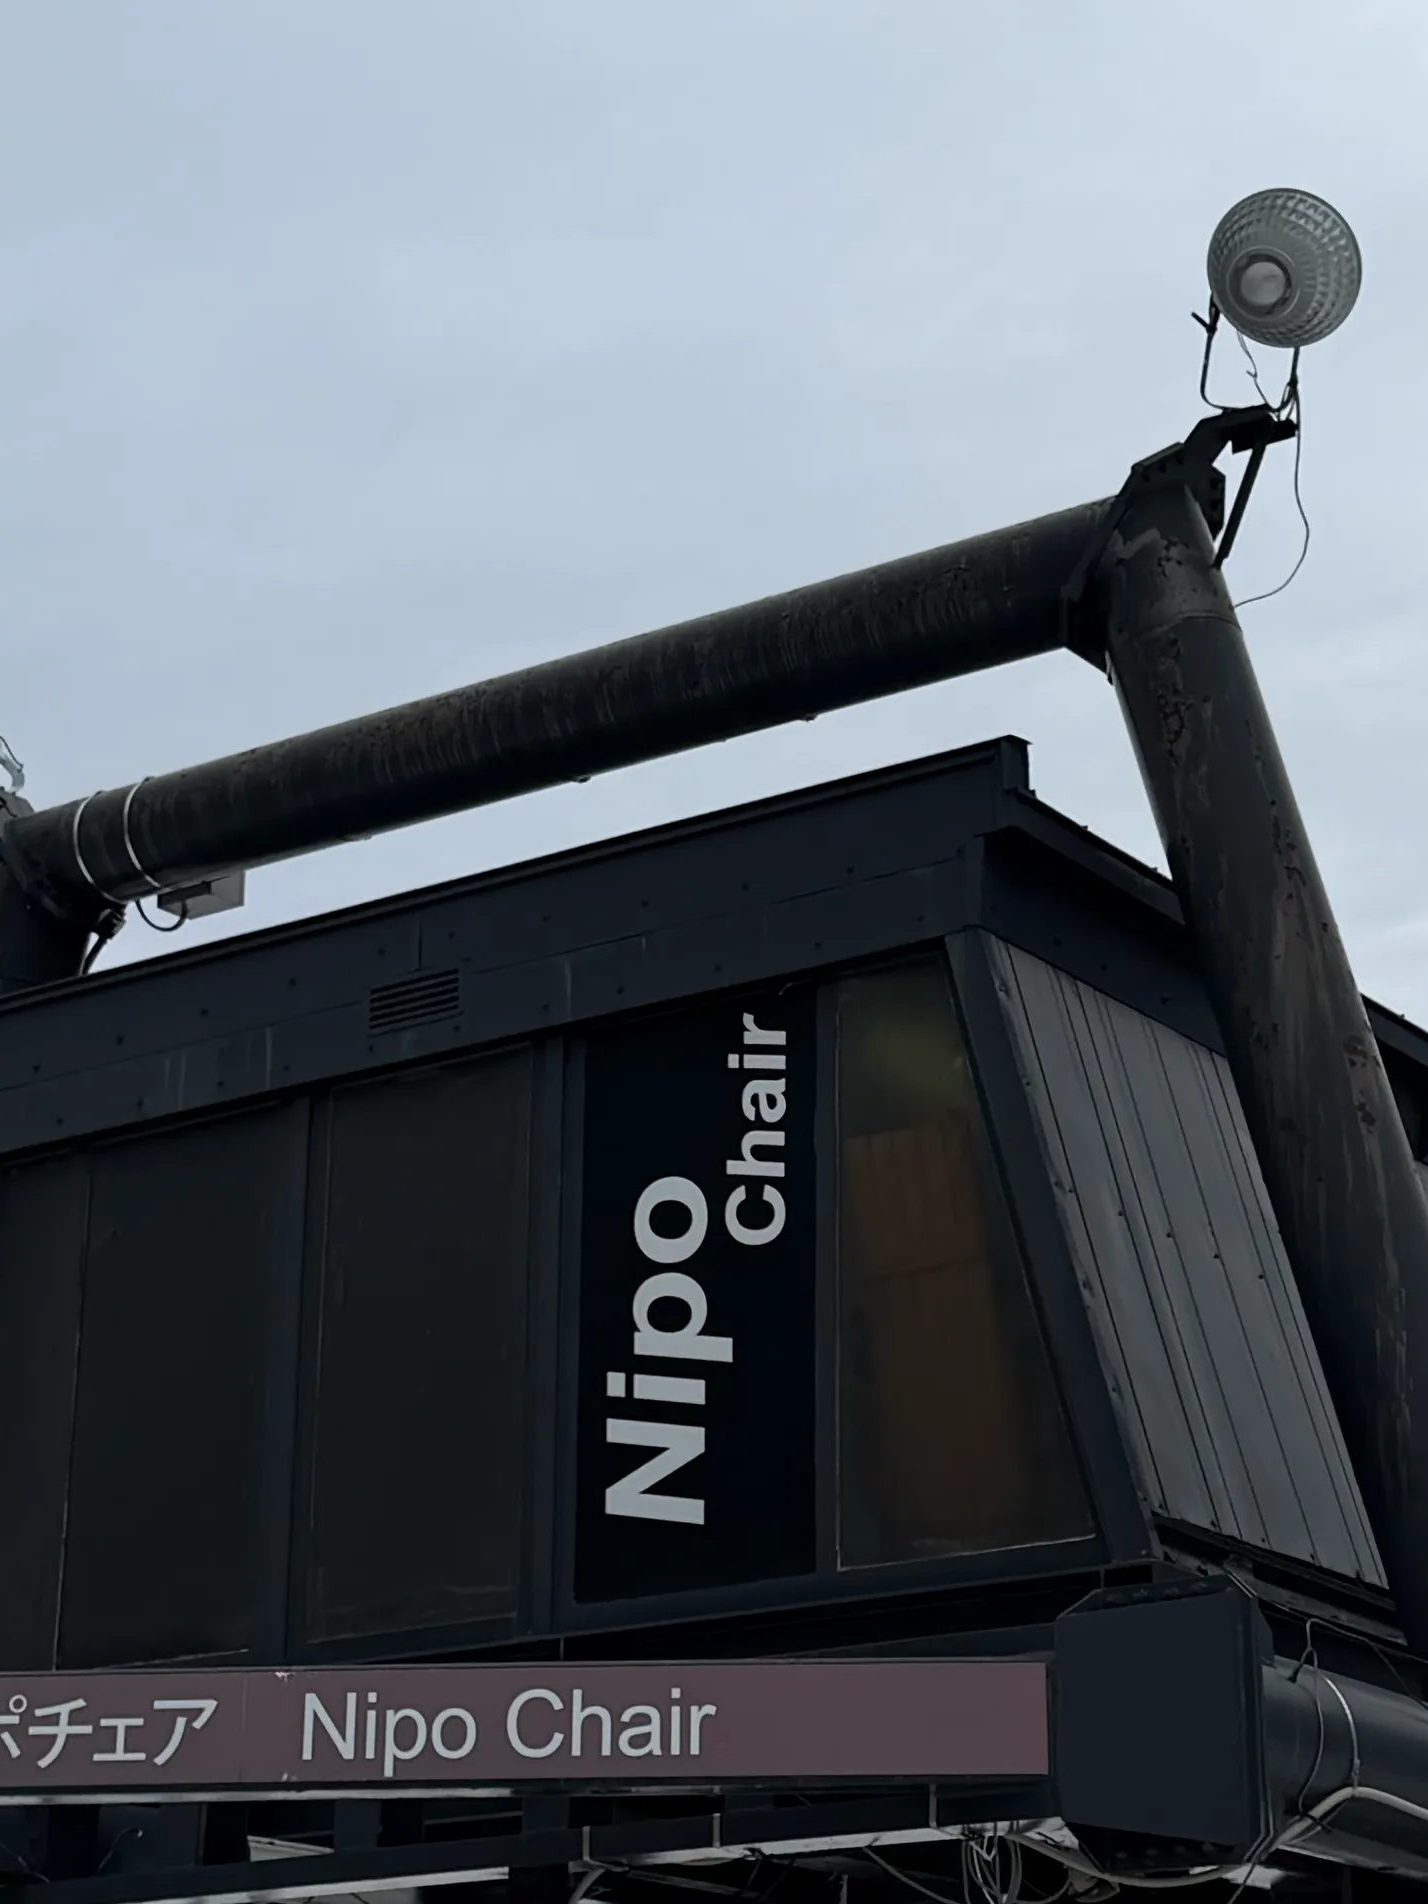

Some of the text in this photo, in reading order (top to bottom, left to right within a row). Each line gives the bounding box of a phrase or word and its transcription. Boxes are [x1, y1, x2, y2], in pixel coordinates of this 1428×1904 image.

[724, 1013, 787, 1246] Chair
[605, 1176, 733, 1525] Nipo
[302, 1692, 477, 1777] Nipo
[506, 1688, 717, 1758] Chair
